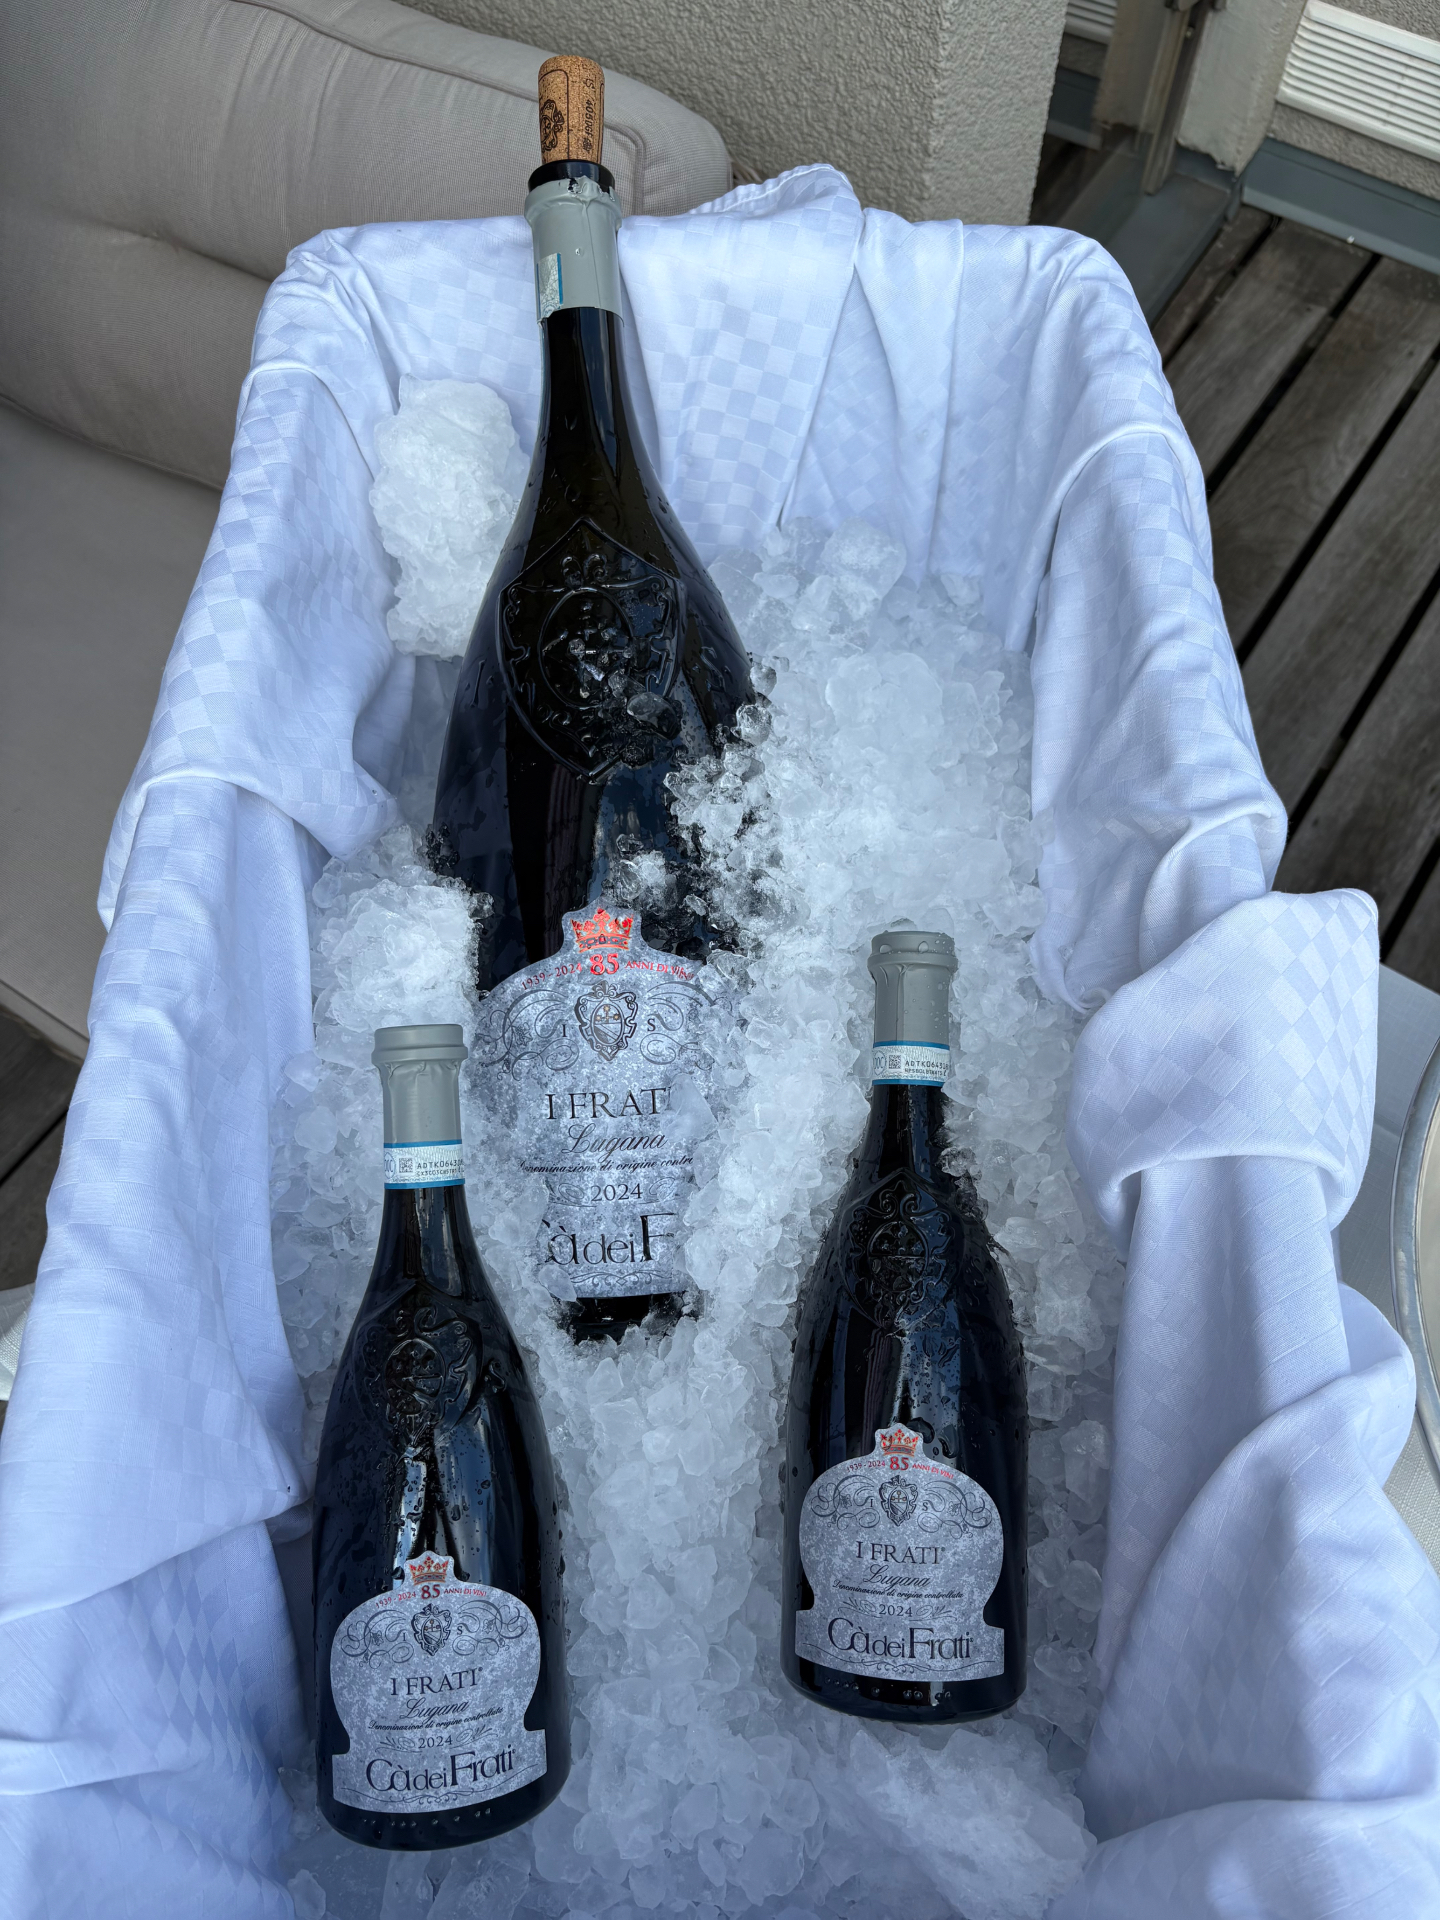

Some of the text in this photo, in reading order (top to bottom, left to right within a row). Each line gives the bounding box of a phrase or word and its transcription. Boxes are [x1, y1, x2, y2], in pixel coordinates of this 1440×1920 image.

[521, 972, 546, 990] 1939
[554, 962, 582, 977] 2024
[590, 953, 619, 975] 85
[625, 961, 654, 971] ANNI
[656, 963, 669, 973] DI
[545, 1093, 557, 1120] I
[561, 1123, 667, 1162] Lugana
[600, 1160, 613, 1171] di
[616, 1159, 661, 1174] origine
[591, 1183, 643, 1202] 2024
[847, 1462, 862, 1472] 1939
[868, 1460, 886, 1469] 2024
[889, 1457, 909, 1471] 85
[912, 1463, 930, 1473] ANNI
[931, 1466, 939, 1474] DI
[856, 1541, 940, 1564] I FRATI
[832, 1579, 964, 1600] Denominazione di origine controllata
[863, 1564, 931, 1591] Lugana
[375, 1596, 392, 1608] 1939
[398, 1591, 416, 1602] 2024
[421, 1584, 441, 1600] 85
[879, 1603, 912, 1618] 2024
[390, 1667, 478, 1696] I FRATI
[368, 1706, 504, 1731] Denominazione di origine controllata
[400, 1698, 470, 1723] Lugana
[418, 1735, 452, 1749] 2024
